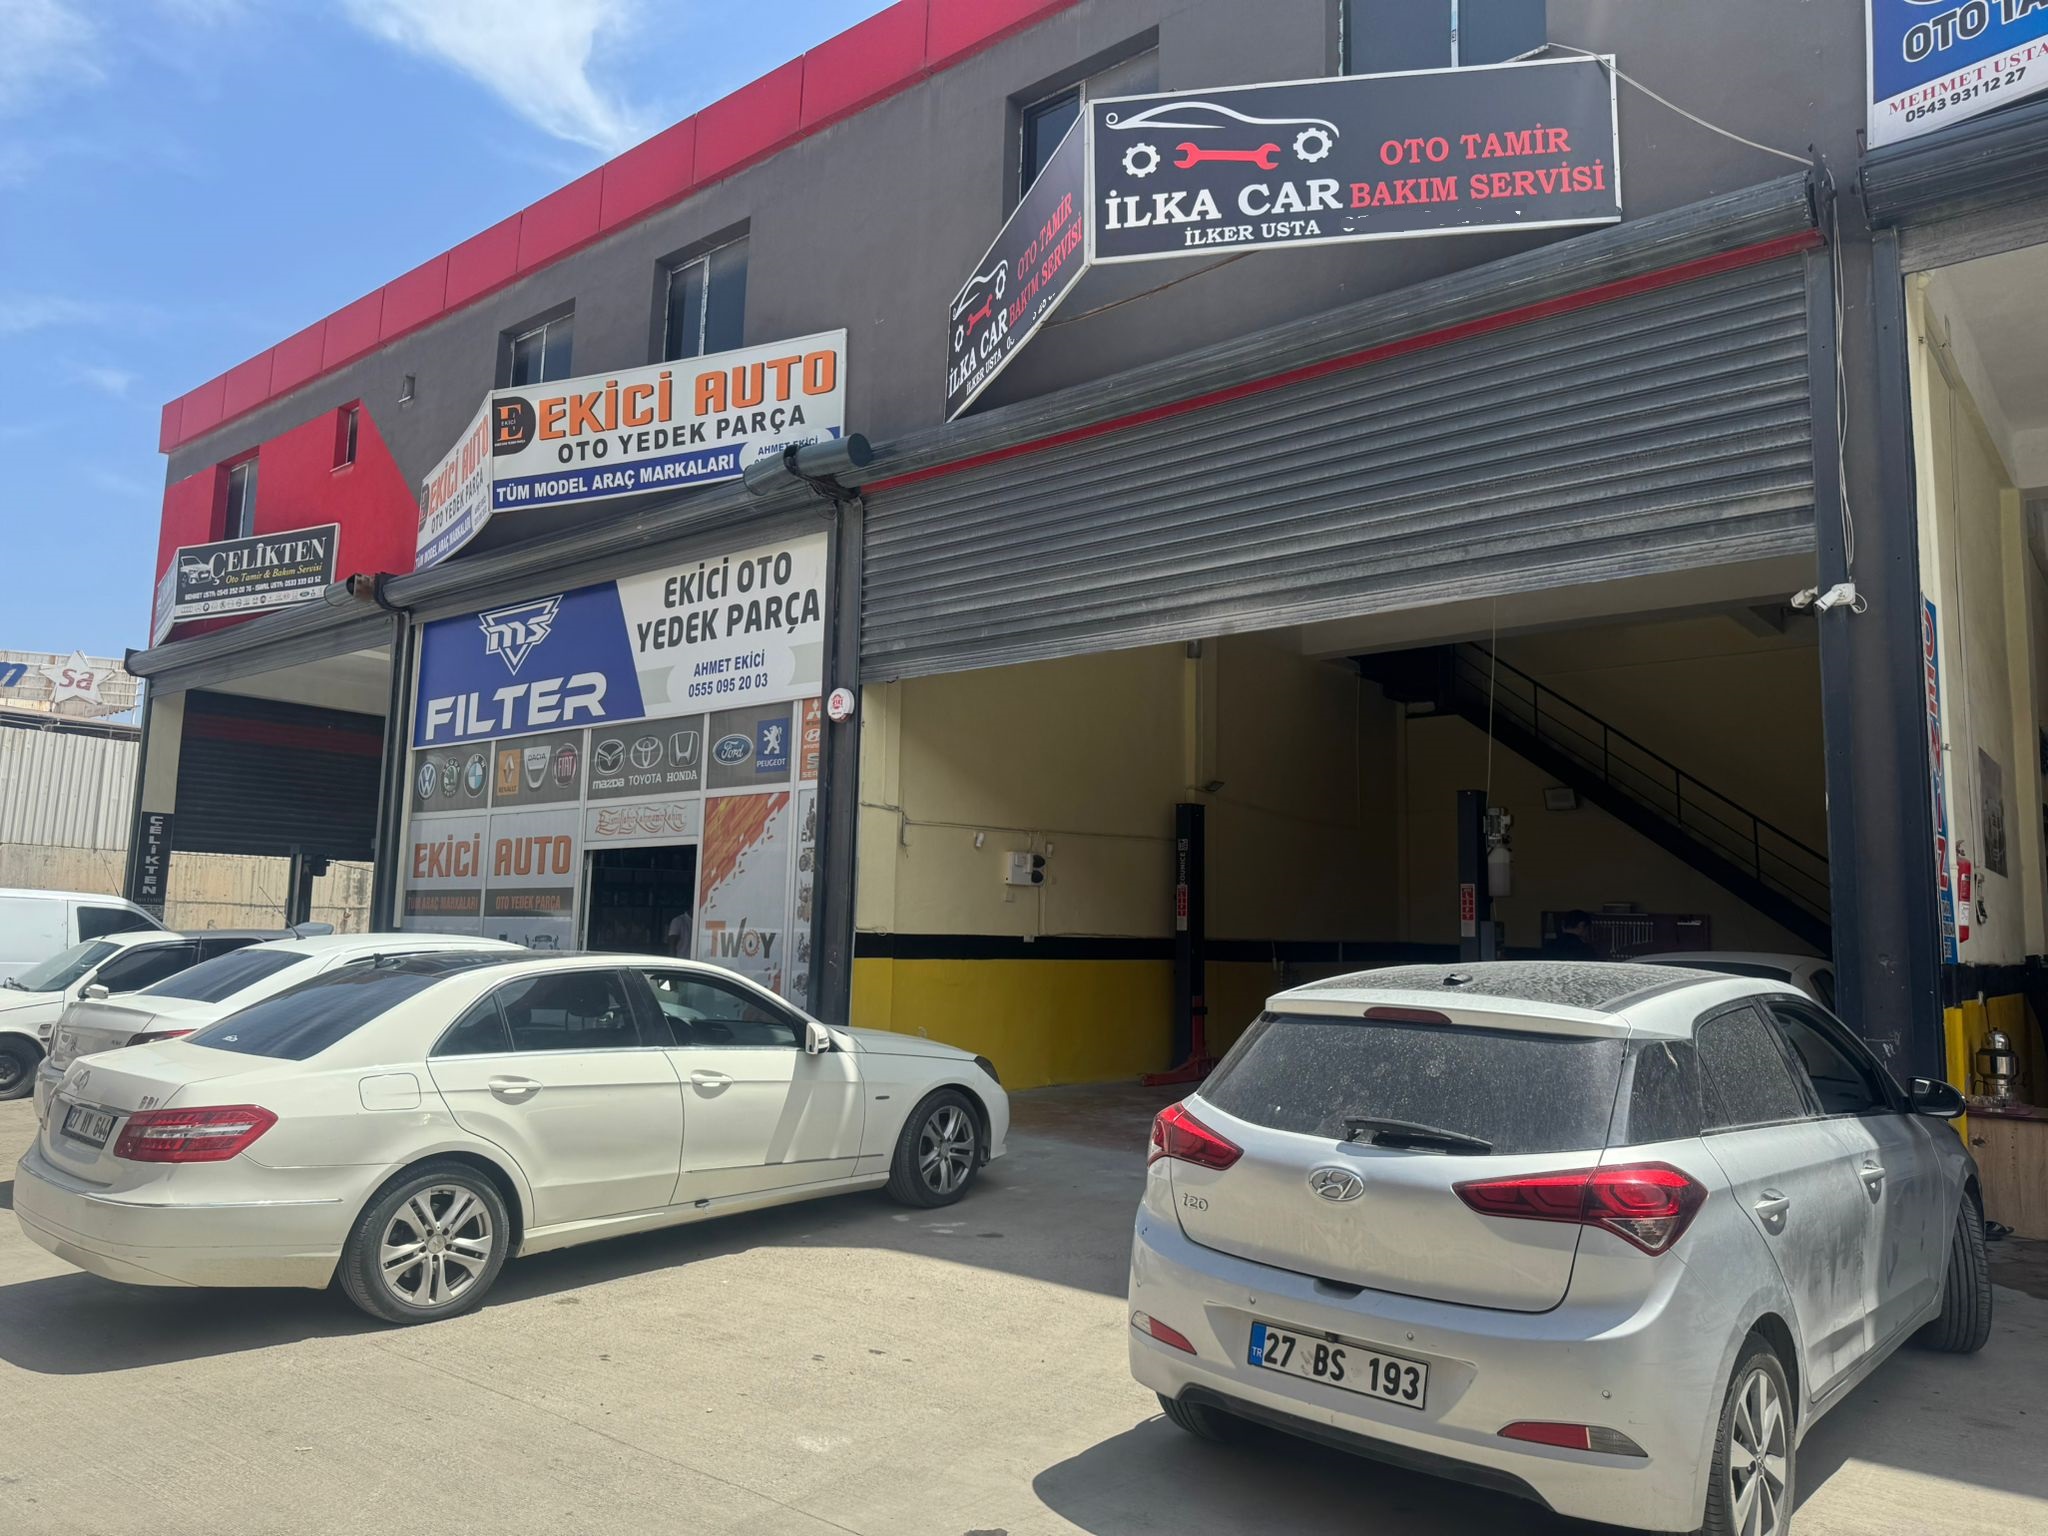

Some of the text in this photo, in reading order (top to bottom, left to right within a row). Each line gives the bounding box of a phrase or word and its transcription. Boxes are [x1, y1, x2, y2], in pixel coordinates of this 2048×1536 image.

[1902, 0, 2048, 62] OTO TA
[1889, 42, 2048, 115] MEHMET USTA
[1905, 66, 2026, 122] 0543 931 12 27
[1380, 123, 1571, 166] OTO TAMİR
[1104, 179, 1343, 231] İLKA CAR
[1350, 159, 1605, 209] BAKIM SERVİSİ
[1018, 240, 1037, 280] OTO
[1040, 192, 1073, 252] TAMİR
[1184, 224, 1254, 247] İLKER
[1261, 219, 1321, 240] USTA
[1008, 272, 1039, 328] BAKIM
[1042, 211, 1083, 286] SERVİSİ
[948, 308, 1008, 399] İLKA CAR
[985, 347, 1002, 374] USTA
[539, 350, 837, 441] EKİCİ AUTO
[558, 404, 806, 464] OTO YEDEK PARÇA
[496, 482, 530, 503] TÜM
[534, 477, 588, 499] MODEL
[591, 470, 635, 494] ARAÇ
[639, 453, 735, 485] MARKALARI
[209, 537, 327, 586] ÇELİKTEN
[663, 551, 793, 609] EKİCİ OTO
[636, 588, 820, 653] YEDEK PARÇA
[59, 668, 95, 691] sa
[688, 672, 768, 699] 0555 095 20 03
[693, 648, 765, 678] AHMET EKİCİ
[425, 671, 608, 740] FILTER
[557, 756, 574, 777] FIAT
[721, 741, 744, 759] Ford
[756, 757, 785, 768] PEUGEOT
[628, 773, 661, 786] TOYOTA
[667, 769, 697, 782] HONDA
[413, 832, 572, 878] EKİCİ AUTO
[1251, 1333, 1420, 1400] TR 27 BS 193
